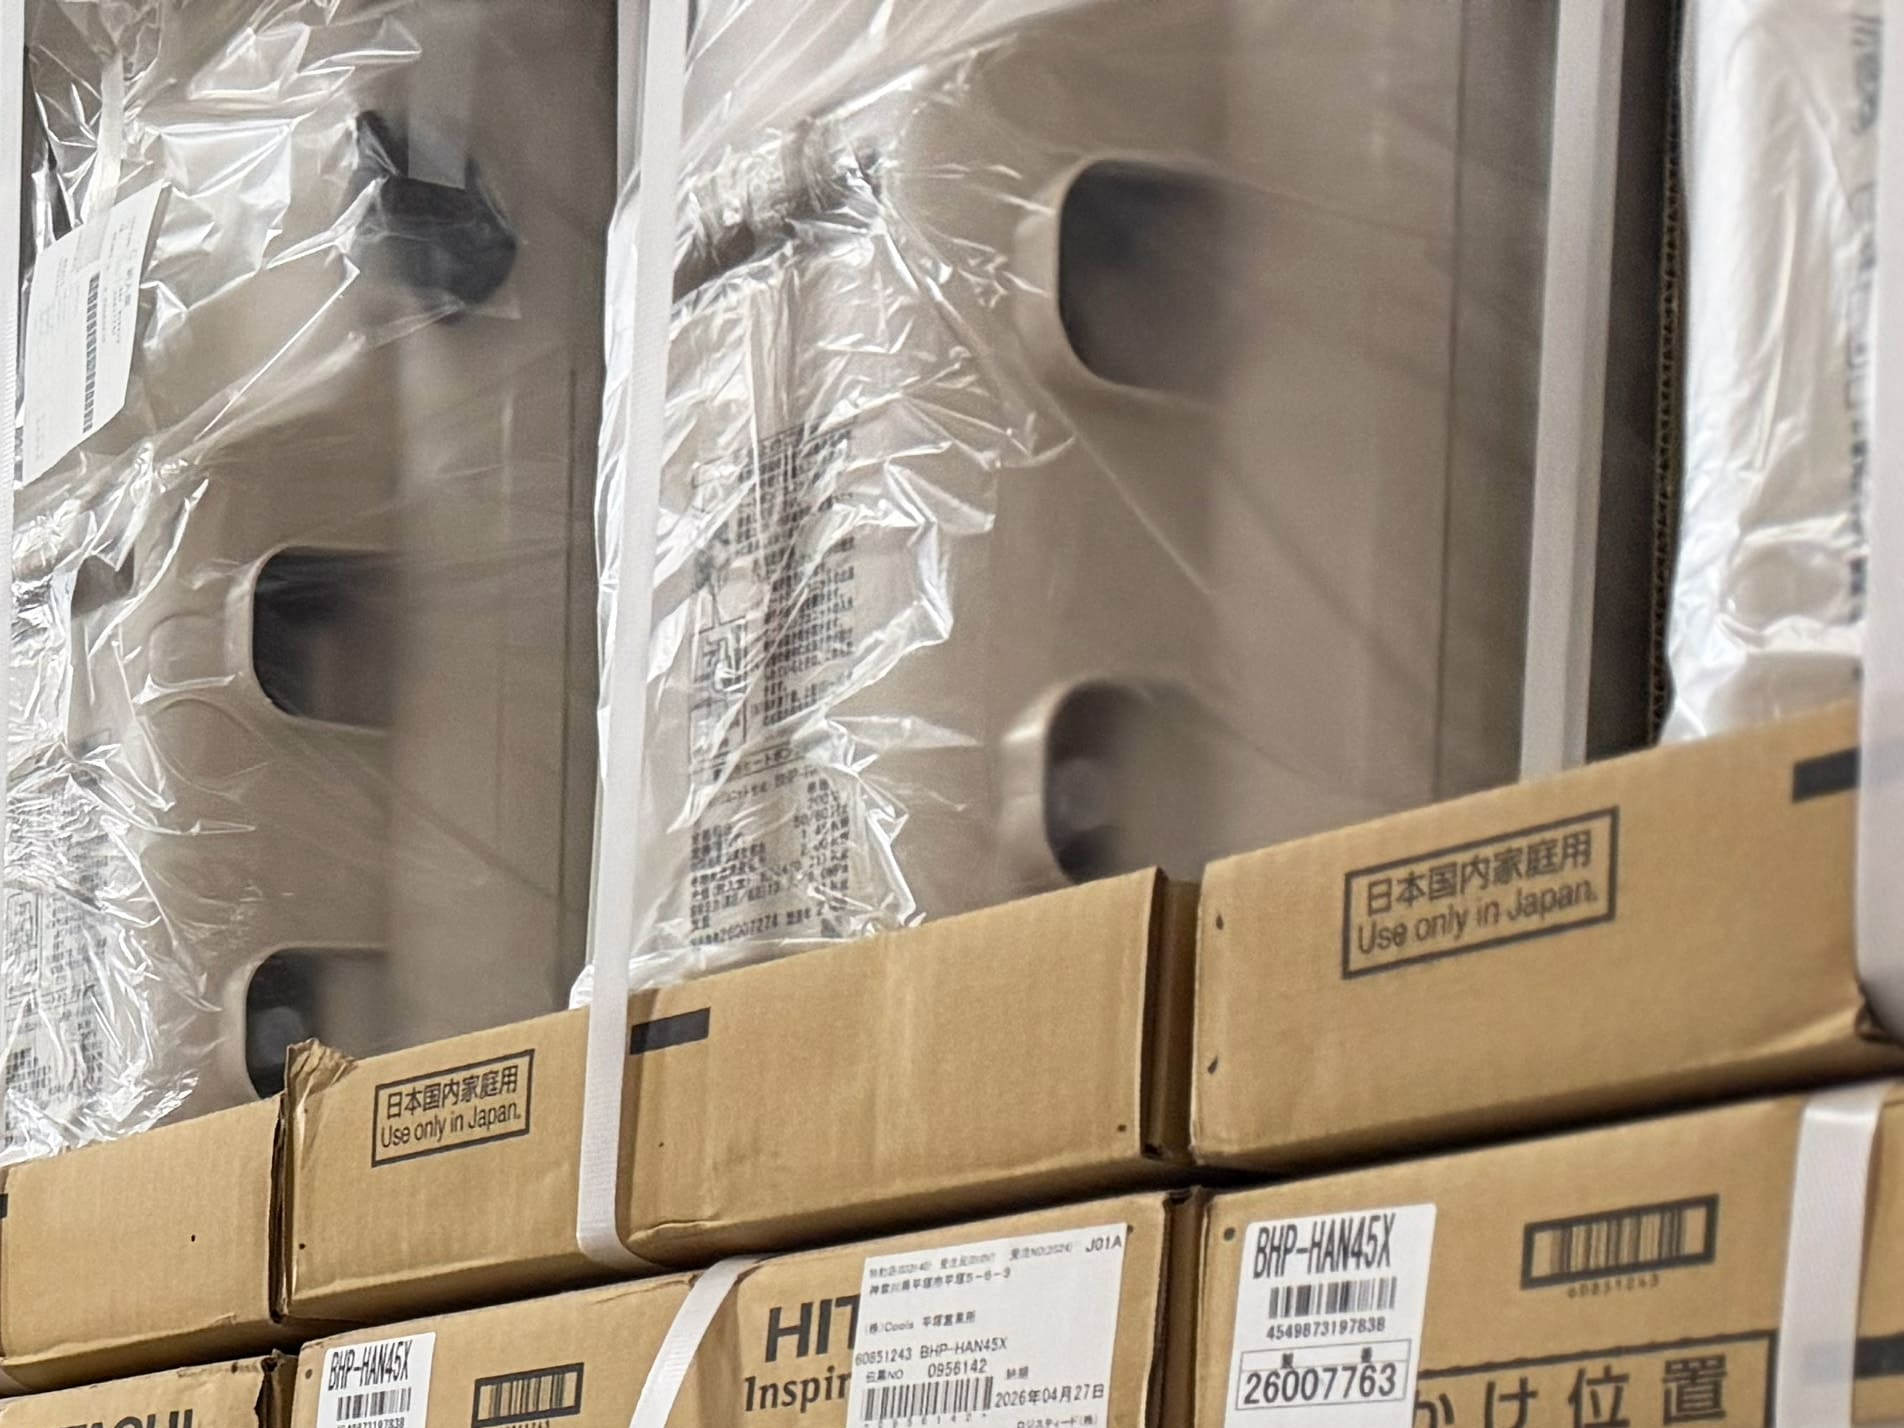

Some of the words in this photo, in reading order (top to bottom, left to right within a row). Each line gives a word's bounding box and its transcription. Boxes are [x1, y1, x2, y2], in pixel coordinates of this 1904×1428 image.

[1366, 830, 1592, 918] 日本国内家庭用
[1358, 918, 1408, 955] Use
[1415, 905, 1468, 945] only
[1477, 897, 1500, 927] in
[386, 1065, 519, 1121] 日本国内家庭用
[380, 1125, 410, 1150] Use
[414, 1116, 446, 1143] only
[451, 1112, 464, 1134] in
[468, 1102, 521, 1130] Japan.
[1085, 1235, 1123, 1254] J01A
[1253, 1212, 1397, 1280] BHP-HAN45X
[1266, 1316, 1386, 1342] 4549873197838
[328, 1339, 413, 1391] BHP-HAN45X
[855, 1348, 912, 1366] 60851243
[920, 1336, 1010, 1360] BHP-HAN45X
[927, 1358, 988, 1379] 0956142
[744, 1373, 852, 1413] Inspir
[994, 1383, 1105, 1410] 2026年04月27日
[1243, 1362, 1398, 1405] 26007763
